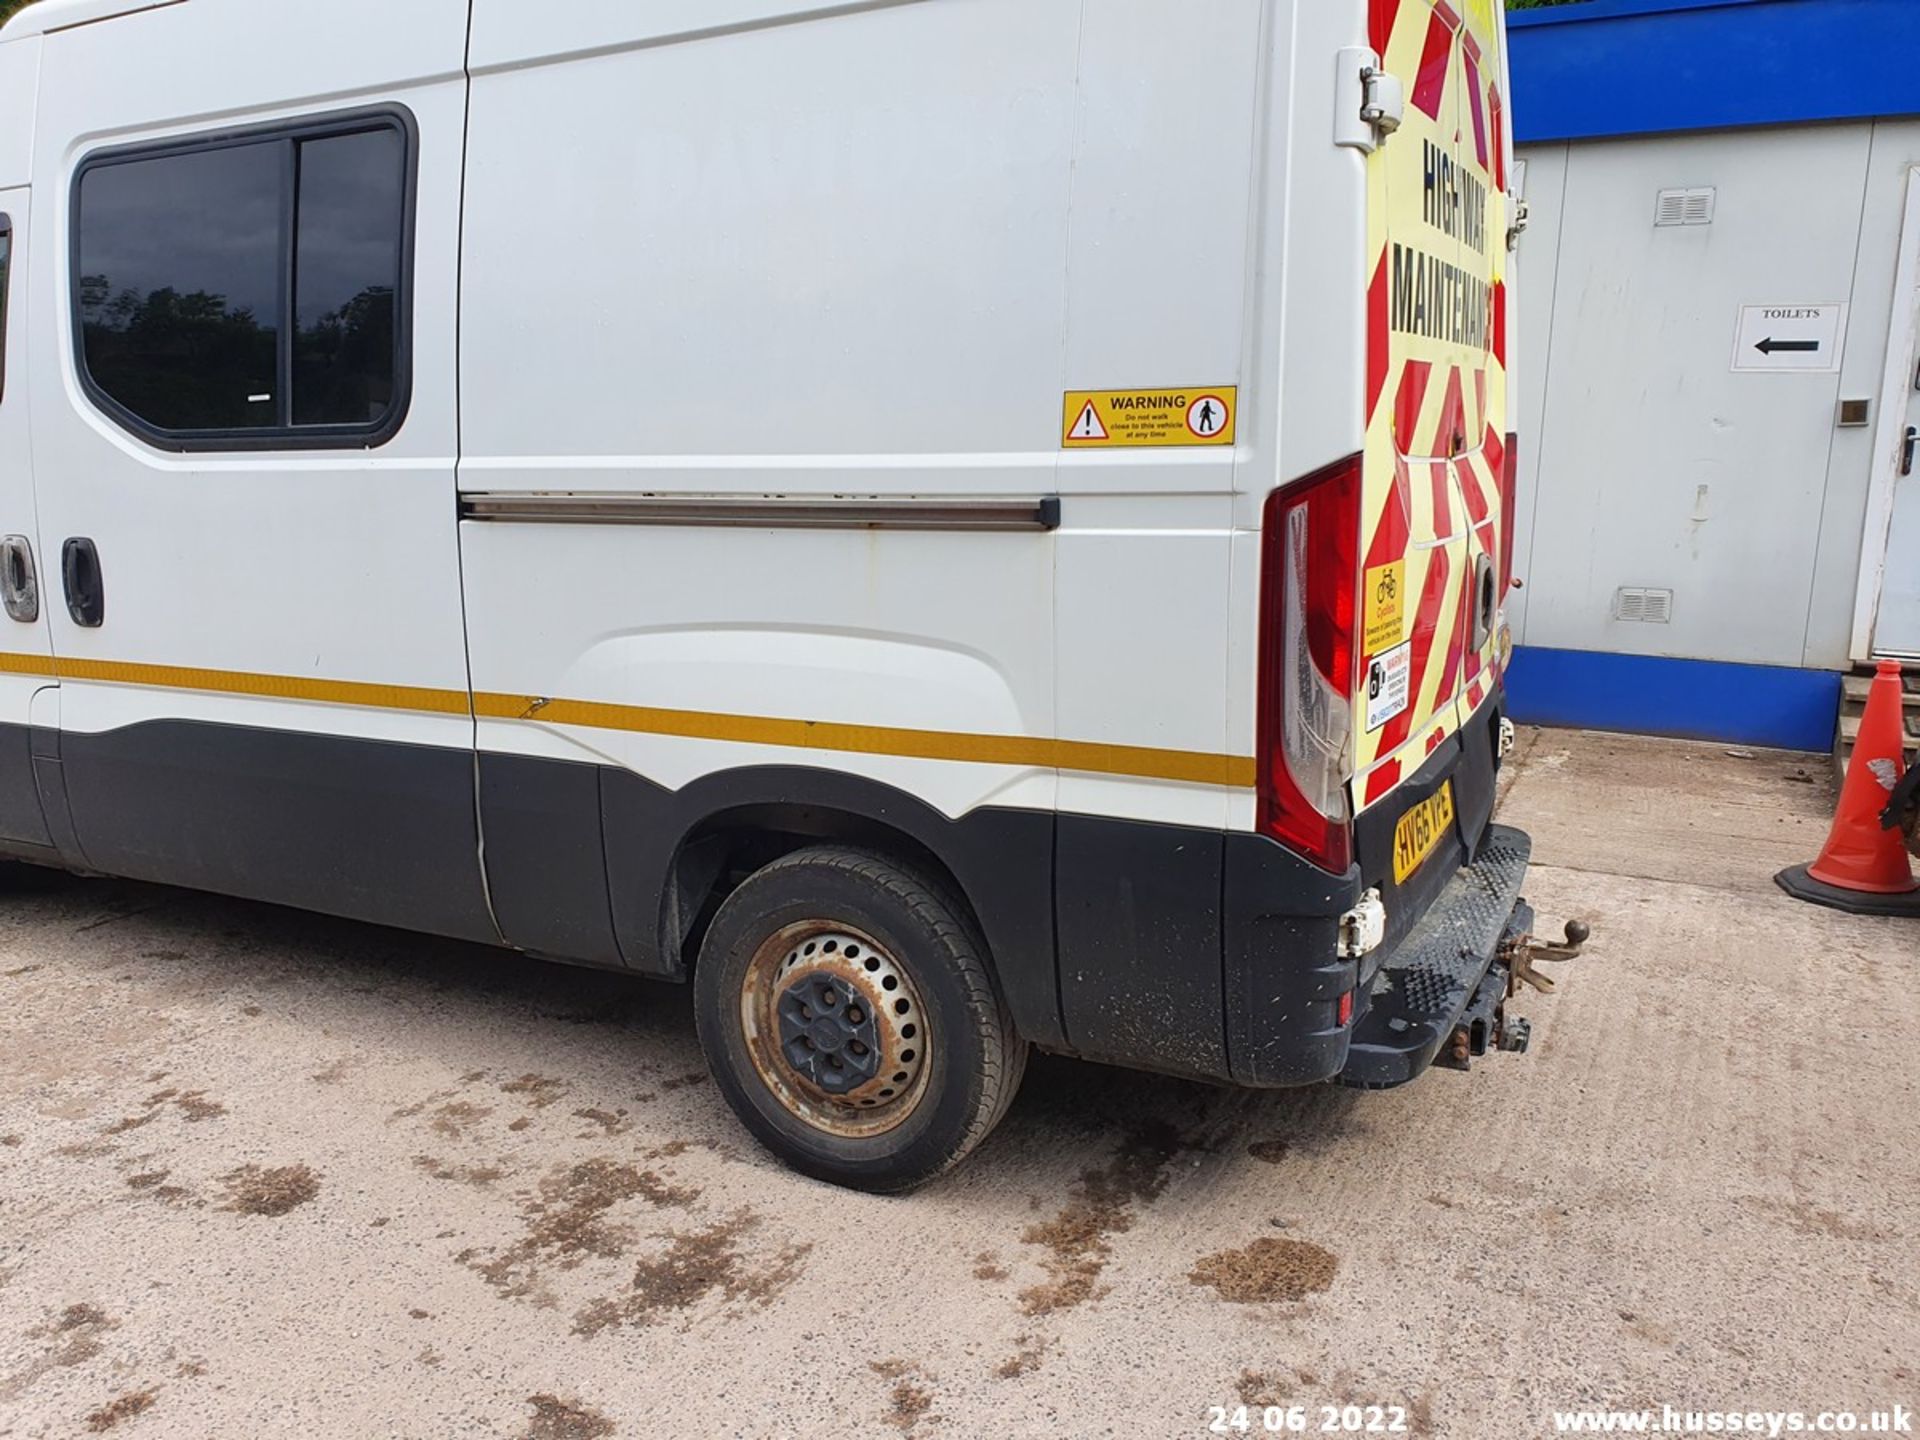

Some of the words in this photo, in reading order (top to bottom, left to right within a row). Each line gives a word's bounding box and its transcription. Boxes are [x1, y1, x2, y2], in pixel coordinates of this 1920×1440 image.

[1423, 138, 1486, 256] HIGHWAY
[1391, 242, 1492, 352] MAINTENANCE
[1762, 308, 1820, 319] TOILETS
[1110, 395, 1186, 410] WARNING
[1398, 802, 1430, 870] HV66
[1429, 792, 1449, 833] YPE
